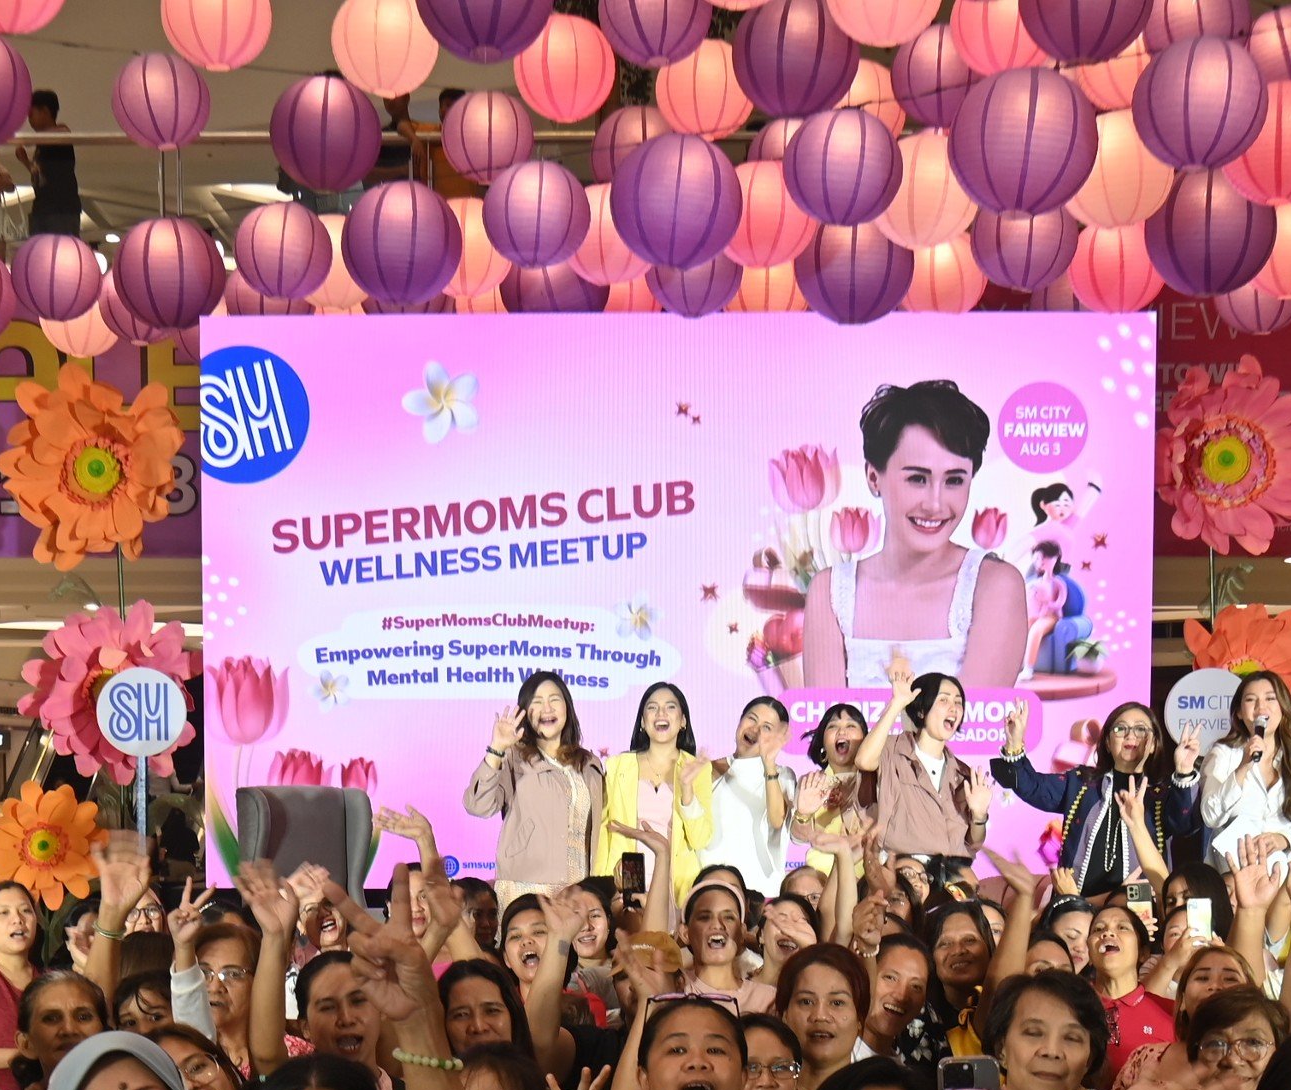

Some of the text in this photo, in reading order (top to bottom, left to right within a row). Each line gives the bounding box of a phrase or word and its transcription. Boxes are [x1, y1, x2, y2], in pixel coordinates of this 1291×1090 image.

[1015, 405, 1071, 420] SM CITY
[1003, 421, 1086, 438] FAIRVIEW
[1020, 441, 1050, 456] AUG
[272, 480, 696, 554] SUPERMOMS CLUB
[319, 532, 648, 586] WELLNESS MEETUP
[381, 613, 596, 634] #SuperMomsClubMeetup:
[315, 639, 662, 669] Empowering SuperMoms Through
[367, 666, 610, 688] Mental Health Wlness
[109, 682, 169, 742] SM
[1177, 695, 1233, 711] SM CIT
[1178, 718, 1230, 731] FAIRVIE
[462, 861, 496, 870] smsup
